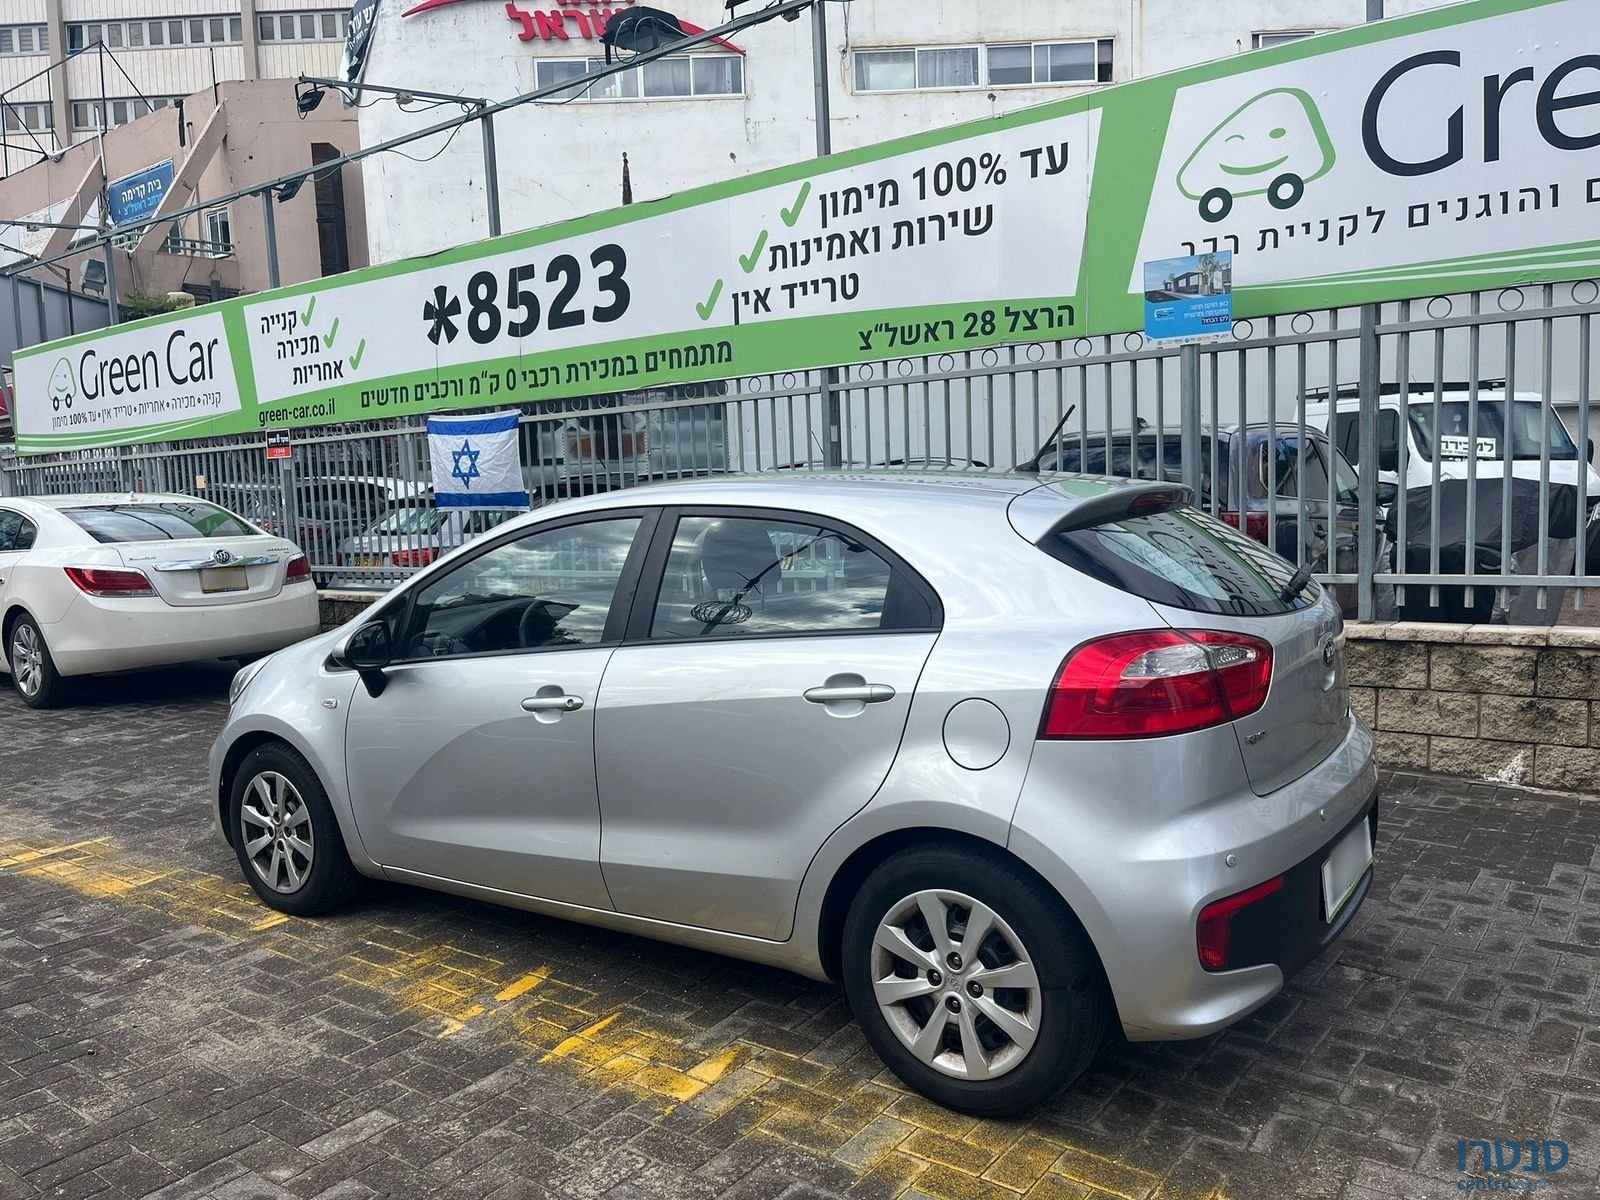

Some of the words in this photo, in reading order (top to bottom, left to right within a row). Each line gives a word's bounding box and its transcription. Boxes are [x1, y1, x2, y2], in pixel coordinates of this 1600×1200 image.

[505, 3, 625, 41] שראל
[1020, 141, 1069, 179] עד
[147, 178, 162, 194] בית
[912, 152, 1007, 201] 100%
[121, 183, 146, 203] קדימה
[819, 178, 899, 229] מימון
[1407, 183, 1559, 228] והוגנים
[891, 204, 994, 250] שירות
[1256, 206, 1387, 251] לקניית
[768, 225, 881, 272] ואמינות
[781, 272, 860, 309] טרייד
[731, 285, 772, 325] אין
[1004, 304, 1075, 333] הרצל
[260, 310, 297, 335] קנייה
[962, 309, 996, 339] 28
[277, 335, 320, 359] מכירה
[645, 340, 732, 373] מתמחים
[79, 349, 159, 400] Green
[166, 329, 218, 385] Car
[292, 359, 344, 385] אחריות
[521, 366, 560, 389] רכבי
[566, 355, 639, 384] במכירת
[414, 378, 463, 402] ורכבים
[506, 368, 517, 391] 0
[138, 400, 165, 415] אחריות
[171, 395, 195, 410] מכירה
[202, 391, 221, 409] קניה
[361, 386, 410, 408] חדשים
[69, 412, 88, 426] 100%
[88, 410, 97, 422] עד
[101, 408, 112, 424] אין
[113, 404, 133, 418] טרייד
[259, 398, 336, 426] green-car.co.il
